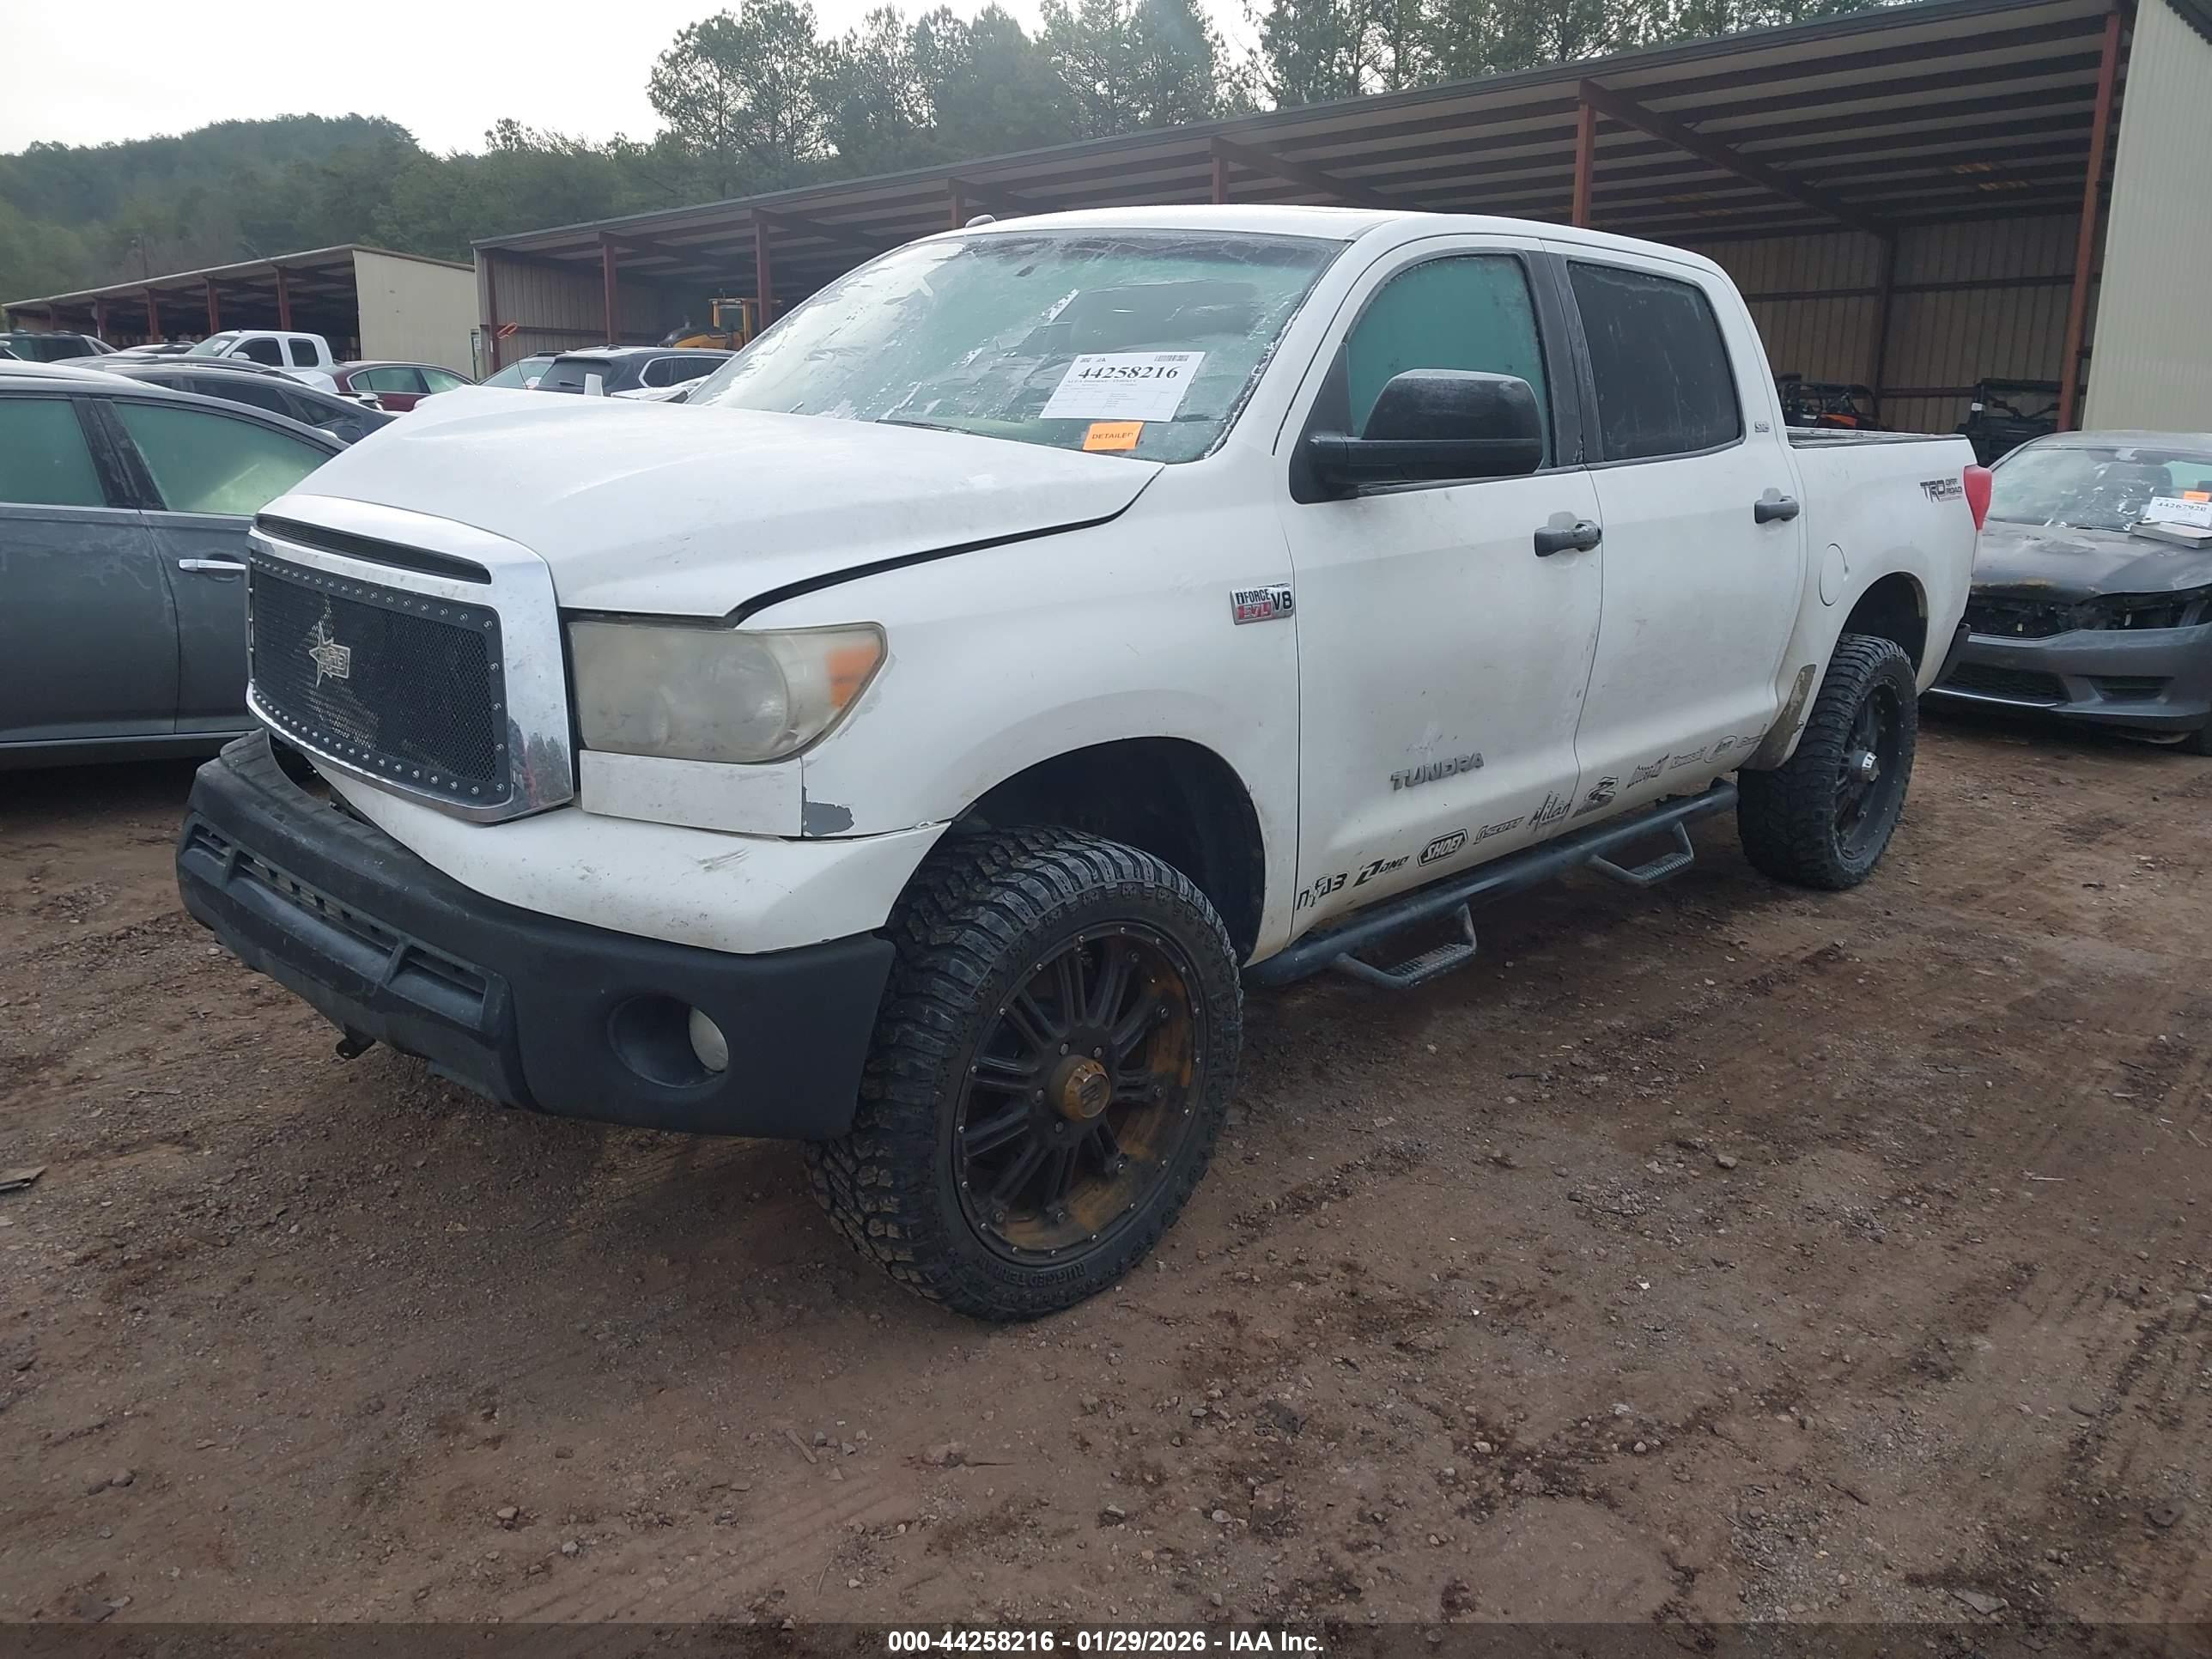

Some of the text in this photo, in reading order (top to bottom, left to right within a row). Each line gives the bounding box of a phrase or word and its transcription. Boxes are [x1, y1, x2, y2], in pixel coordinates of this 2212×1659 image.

[1078, 367, 1182, 379] 44258216
[1919, 479, 1946, 503] TRD
[1271, 591, 1292, 611] V8
[1390, 753, 1485, 791] TUNDRA
